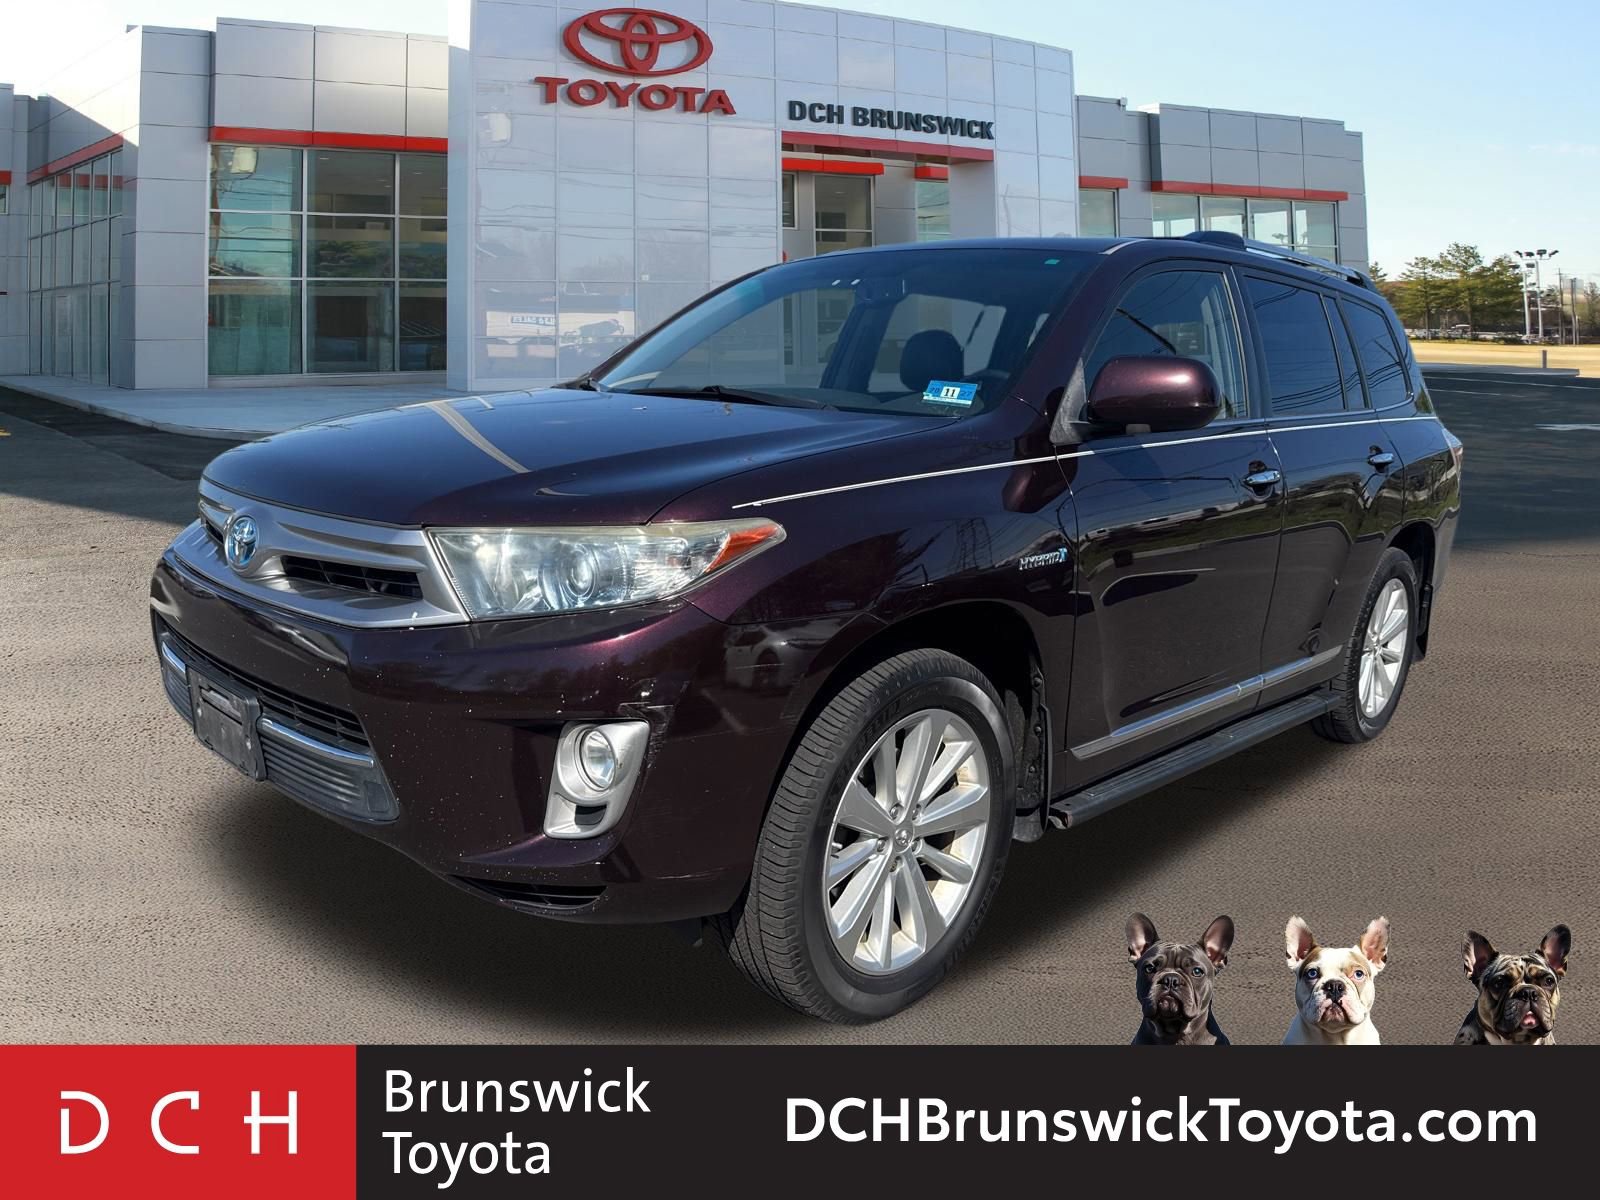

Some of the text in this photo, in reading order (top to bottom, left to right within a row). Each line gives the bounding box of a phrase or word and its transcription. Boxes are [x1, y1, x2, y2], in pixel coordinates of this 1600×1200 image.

[535, 76, 737, 115] TOYOTA
[788, 100, 995, 140] DCH BRUNSWICK
[943, 387, 956, 397] 11
[1019, 551, 1060, 571] HYBRID
